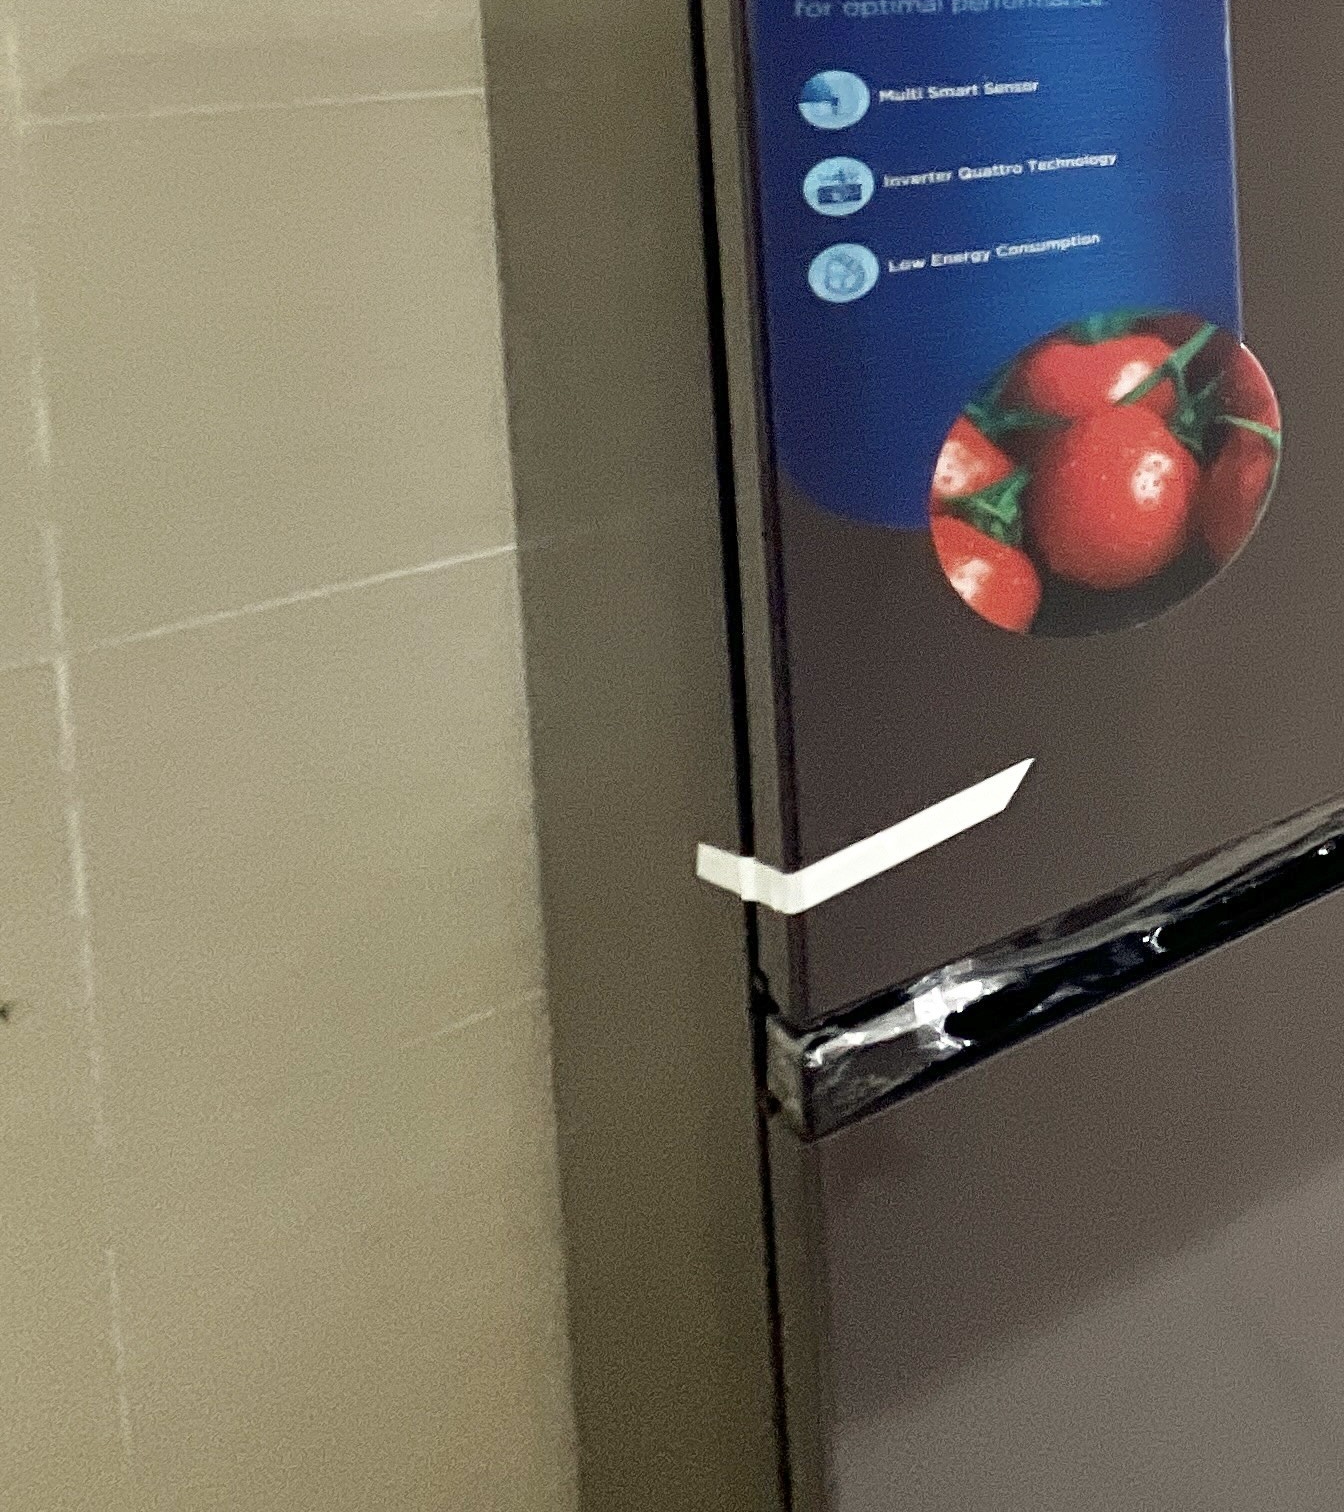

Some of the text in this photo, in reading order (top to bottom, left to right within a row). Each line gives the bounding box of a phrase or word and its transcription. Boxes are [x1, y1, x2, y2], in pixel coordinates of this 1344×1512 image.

[878, 79, 1039, 103] Multi Smart Sensor
[883, 152, 1118, 188] Inverter Quattro Technology
[888, 232, 1101, 273] Low Energy Consumption
